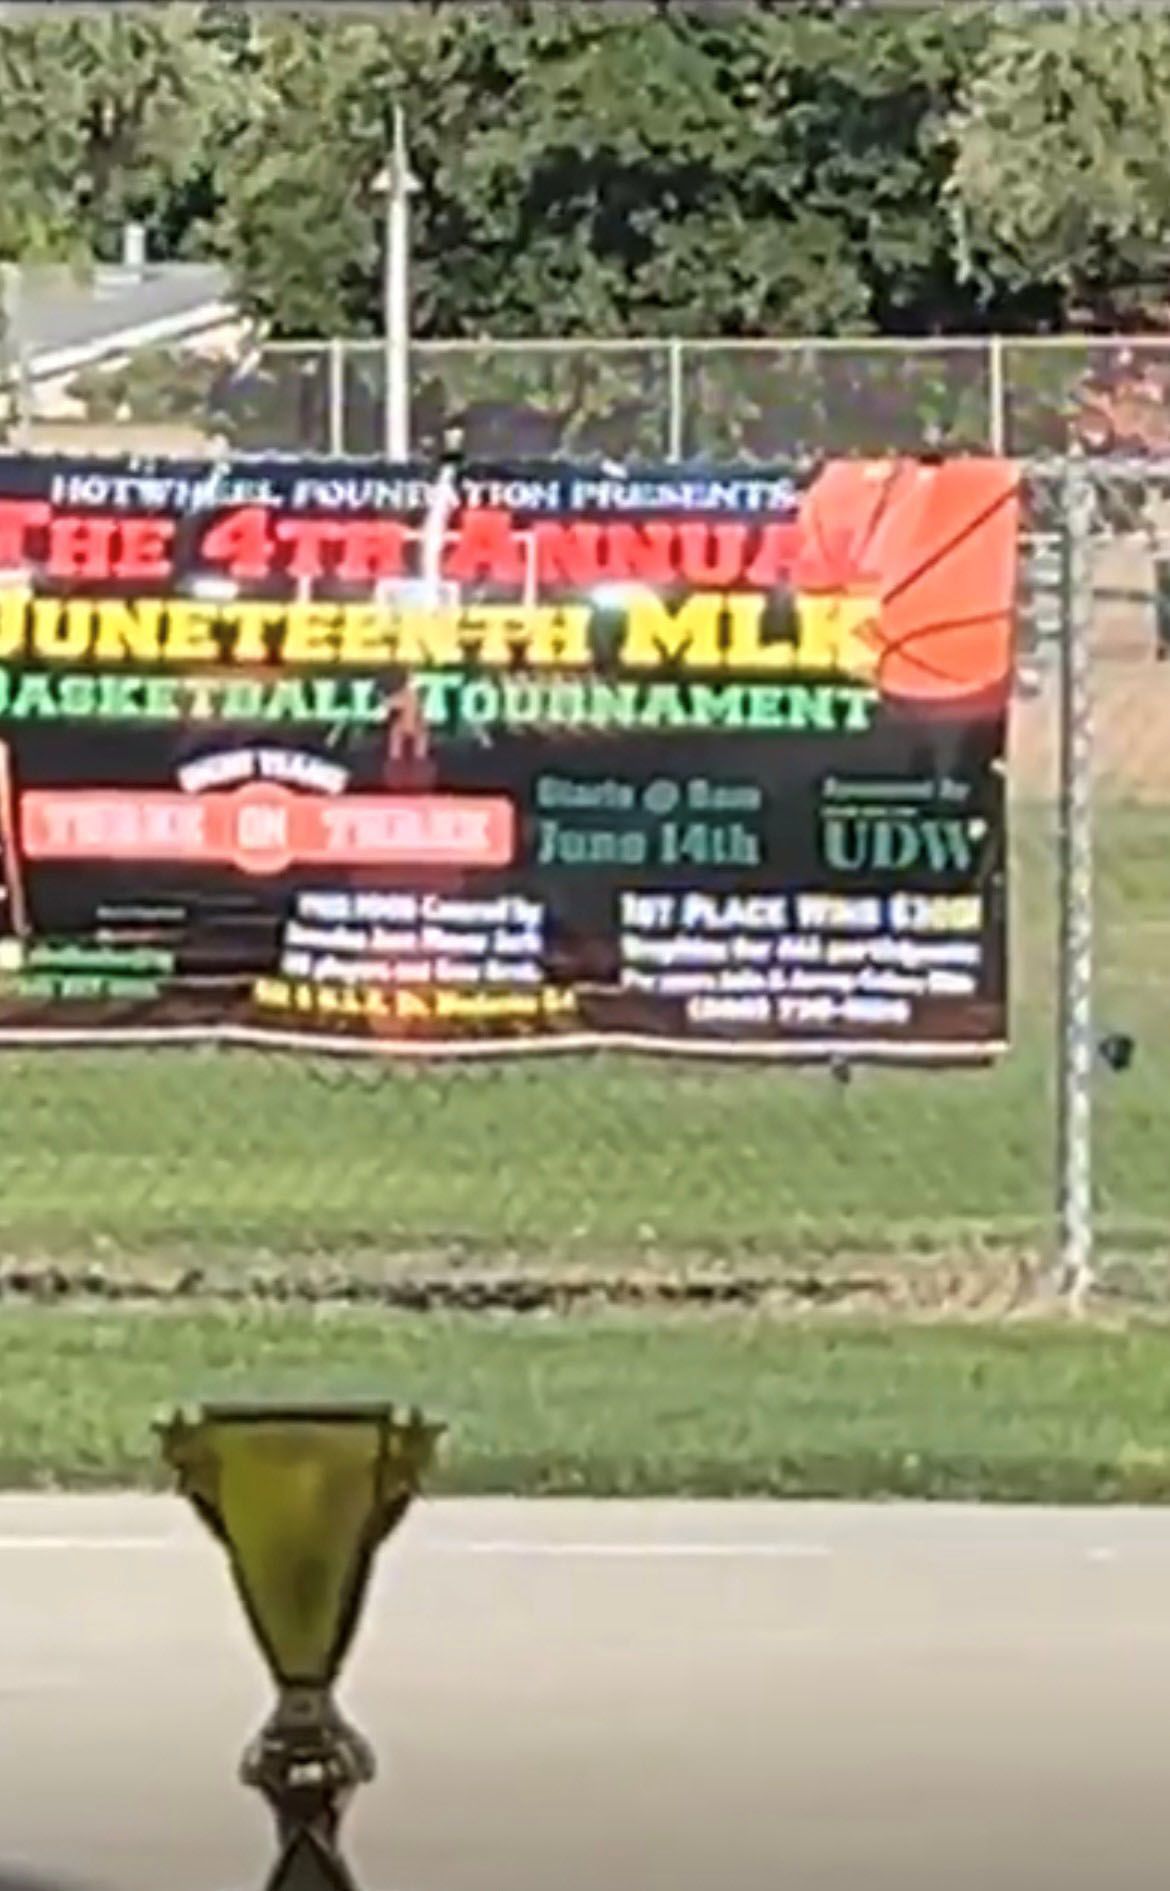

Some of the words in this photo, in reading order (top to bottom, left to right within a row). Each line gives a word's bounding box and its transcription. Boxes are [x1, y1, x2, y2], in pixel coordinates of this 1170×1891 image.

[572, 478, 798, 510] PRESENTS
[0, 588, 591, 665] JUNETEENTH
[620, 584, 882, 670] MLK
[0, 670, 388, 724] ASKETBALL
[412, 672, 878, 732] TOURNAMENT
[537, 819, 648, 866] June
[660, 821, 761, 866] 14th
[822, 817, 972, 872] UDW
